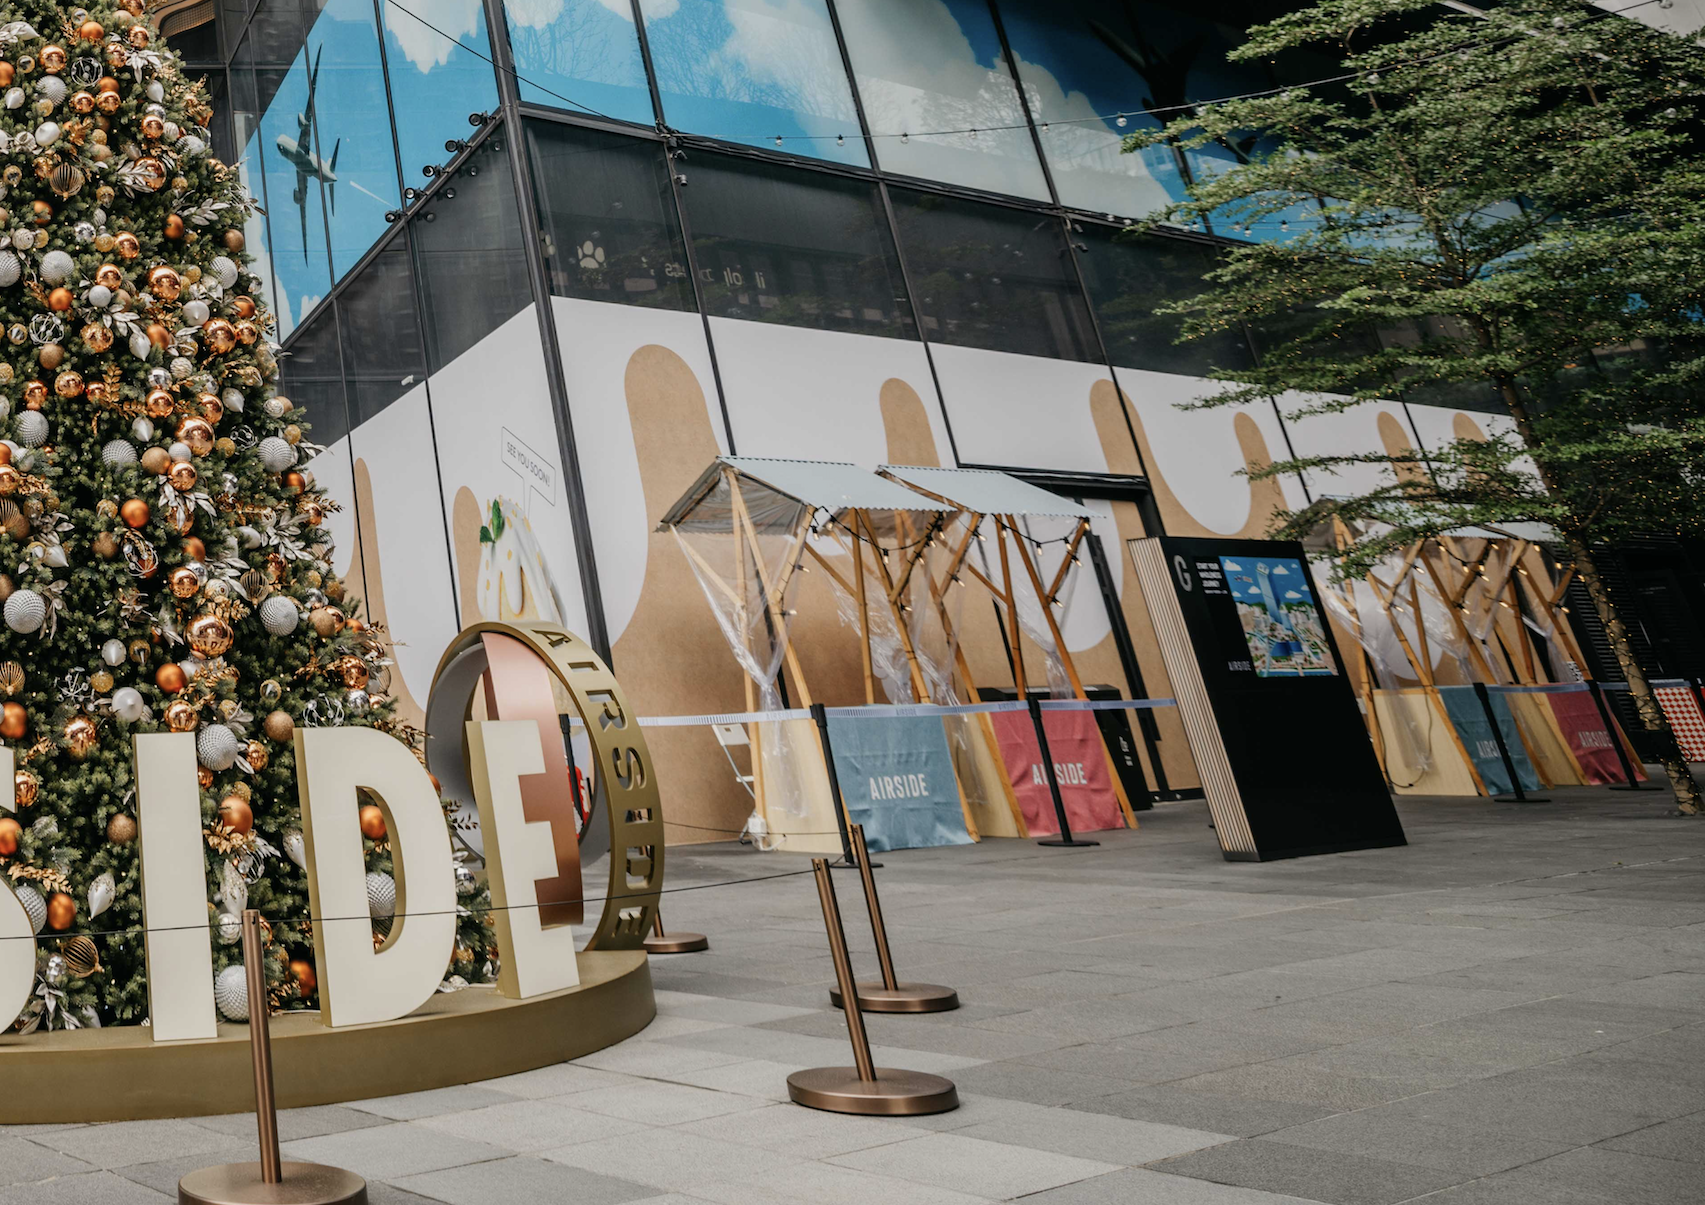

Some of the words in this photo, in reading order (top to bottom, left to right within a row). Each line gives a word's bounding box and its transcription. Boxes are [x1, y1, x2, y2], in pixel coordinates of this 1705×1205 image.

[506, 441, 516, 458] SEE
[517, 449, 530, 469] YOU
[530, 461, 551, 487] SOON!
[1174, 555, 1192, 592] G
[530, 628, 654, 938] AIRSIDE
[870, 773, 929, 801] AIRSIDE
[1032, 762, 1088, 786] AISIDE
